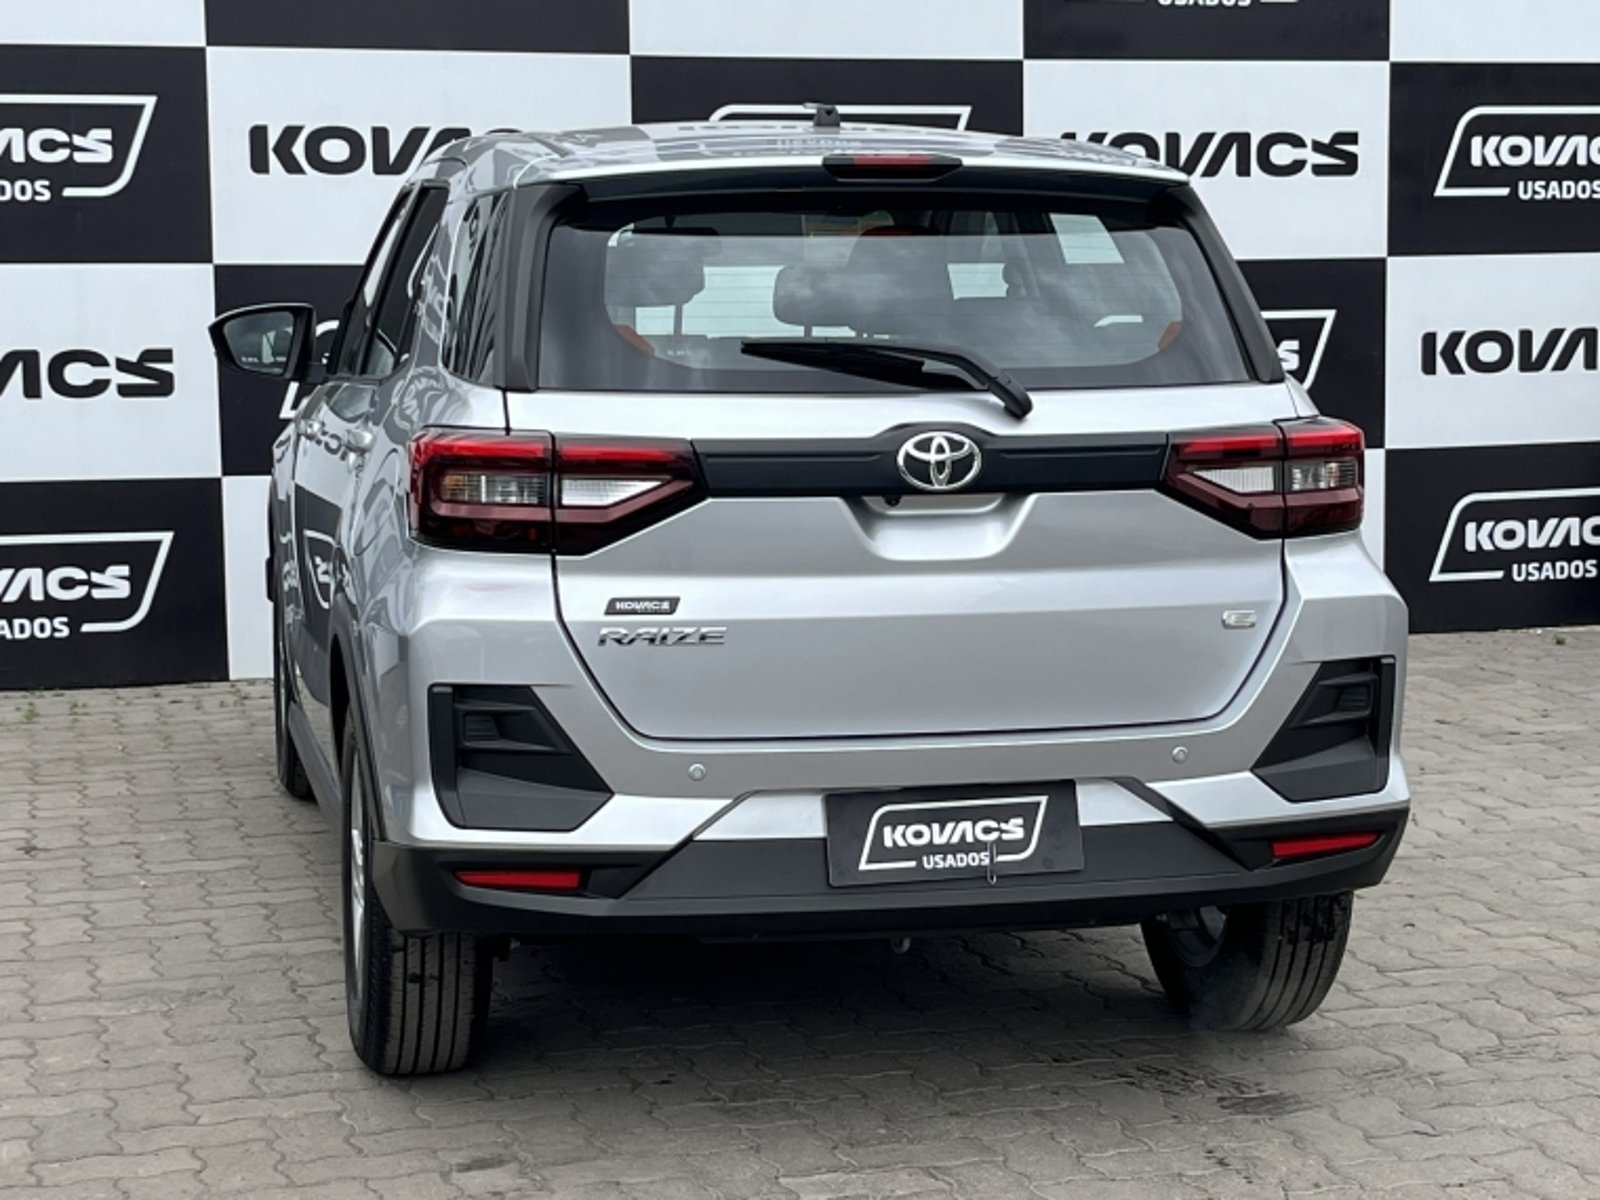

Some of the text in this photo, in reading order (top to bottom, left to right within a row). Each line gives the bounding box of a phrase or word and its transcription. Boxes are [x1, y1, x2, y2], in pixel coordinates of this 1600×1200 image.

[248, 124, 521, 175] KOV
[1060, 131, 1359, 178] OVACS
[1517, 180, 1600, 200] USADOS
[1421, 327, 1599, 376] KOVA
[1512, 559, 1598, 582] USADOS
[598, 626, 728, 647] RAIZE
[883, 817, 1025, 848] KOVACS
[922, 851, 990, 870] USADOS
